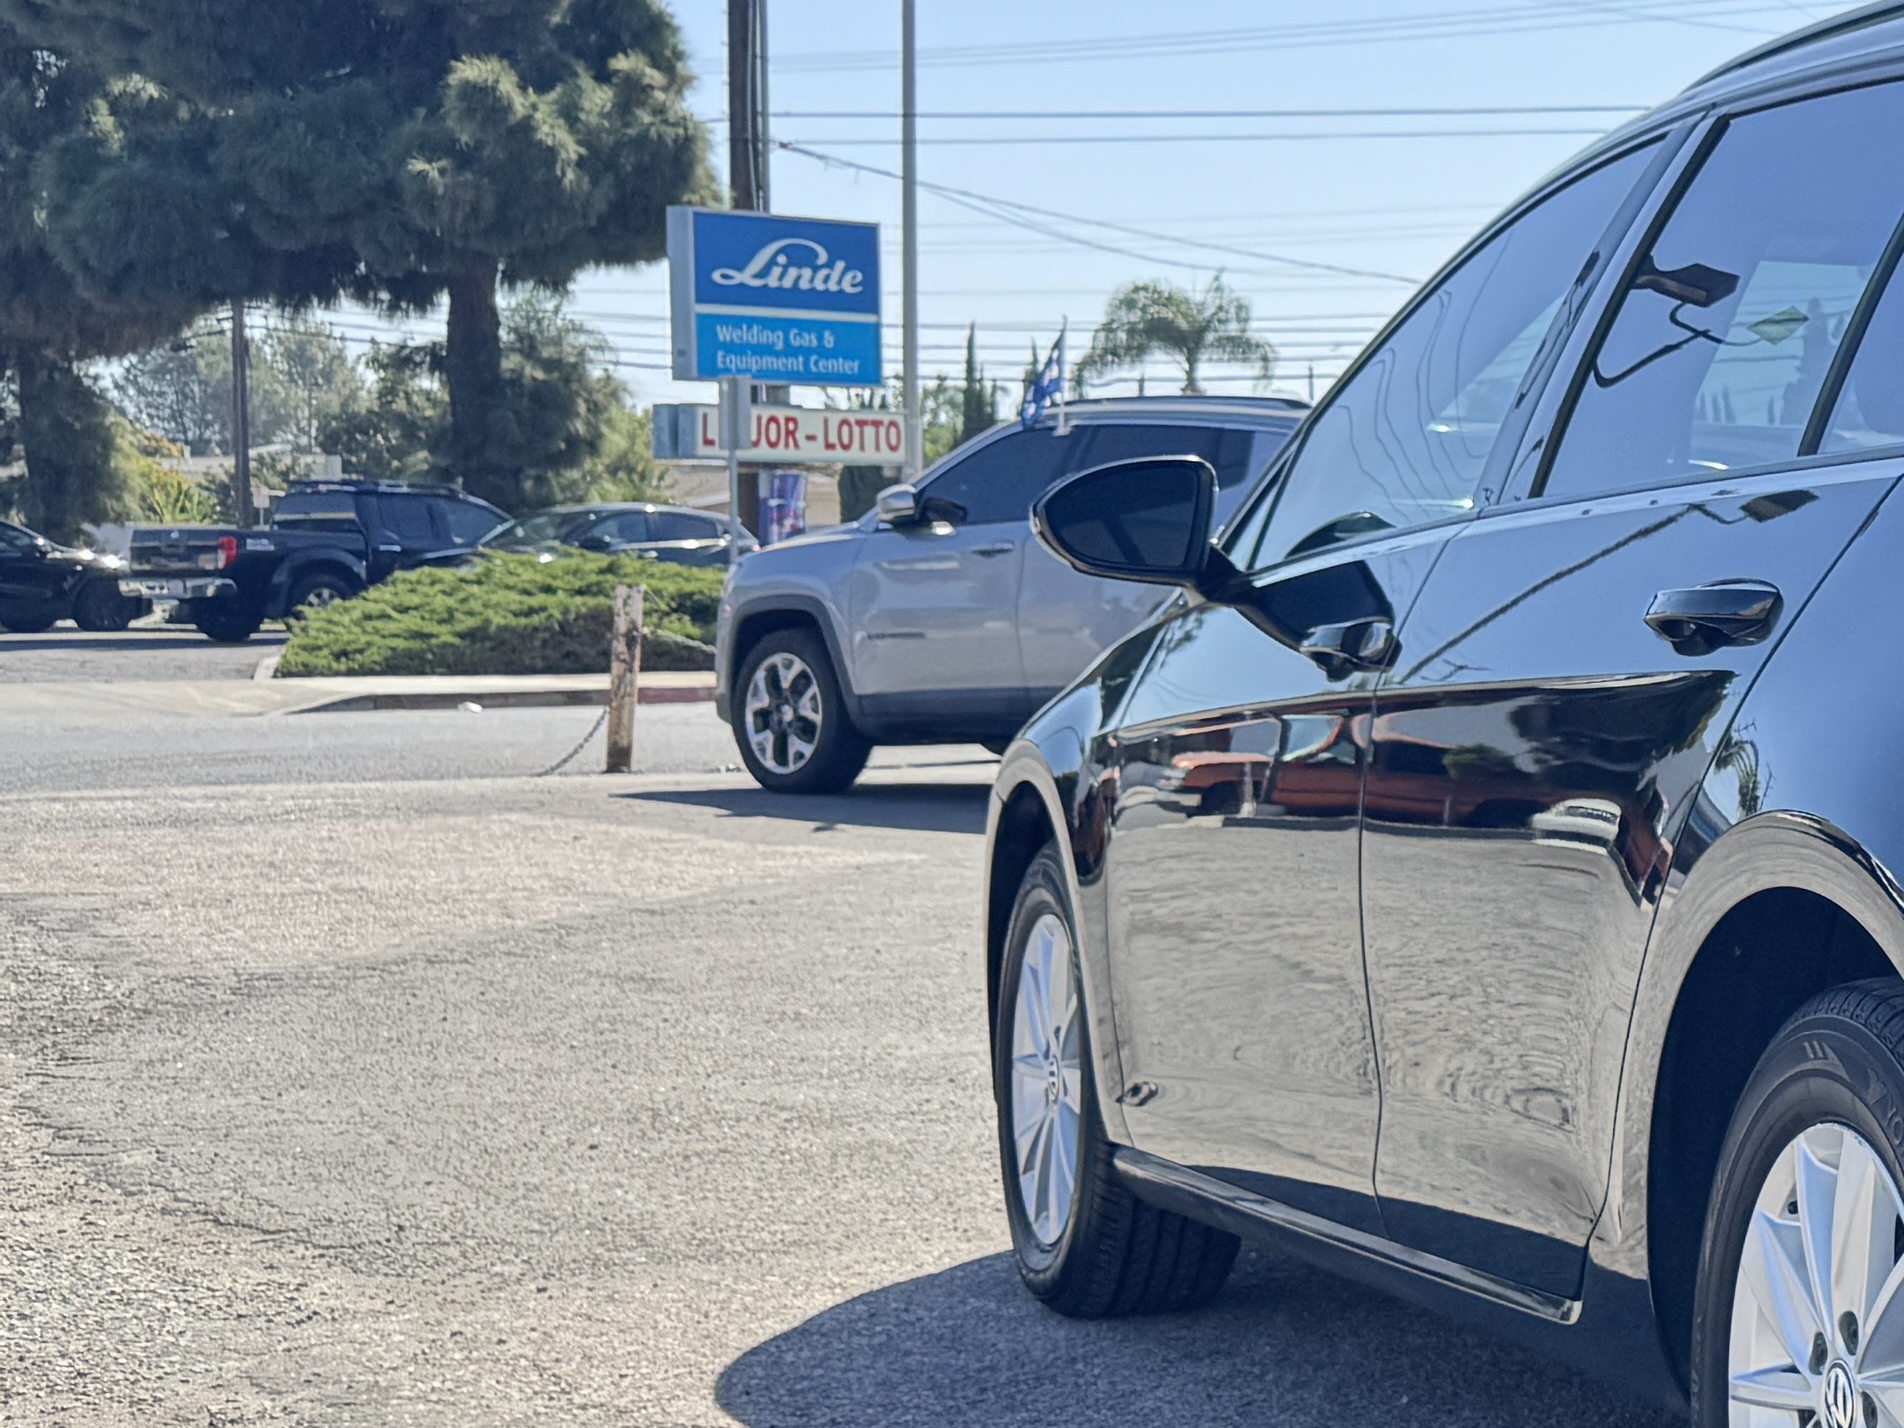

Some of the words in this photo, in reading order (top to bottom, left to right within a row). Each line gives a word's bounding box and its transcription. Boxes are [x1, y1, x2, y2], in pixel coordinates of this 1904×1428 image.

[711, 237, 864, 294] Linde
[716, 324, 785, 350] Welding
[789, 328, 818, 348] Gas
[823, 330, 835, 349] &
[716, 350, 803, 372] Equipment
[809, 355, 860, 374] Center
[823, 416, 902, 452] LOTTO
